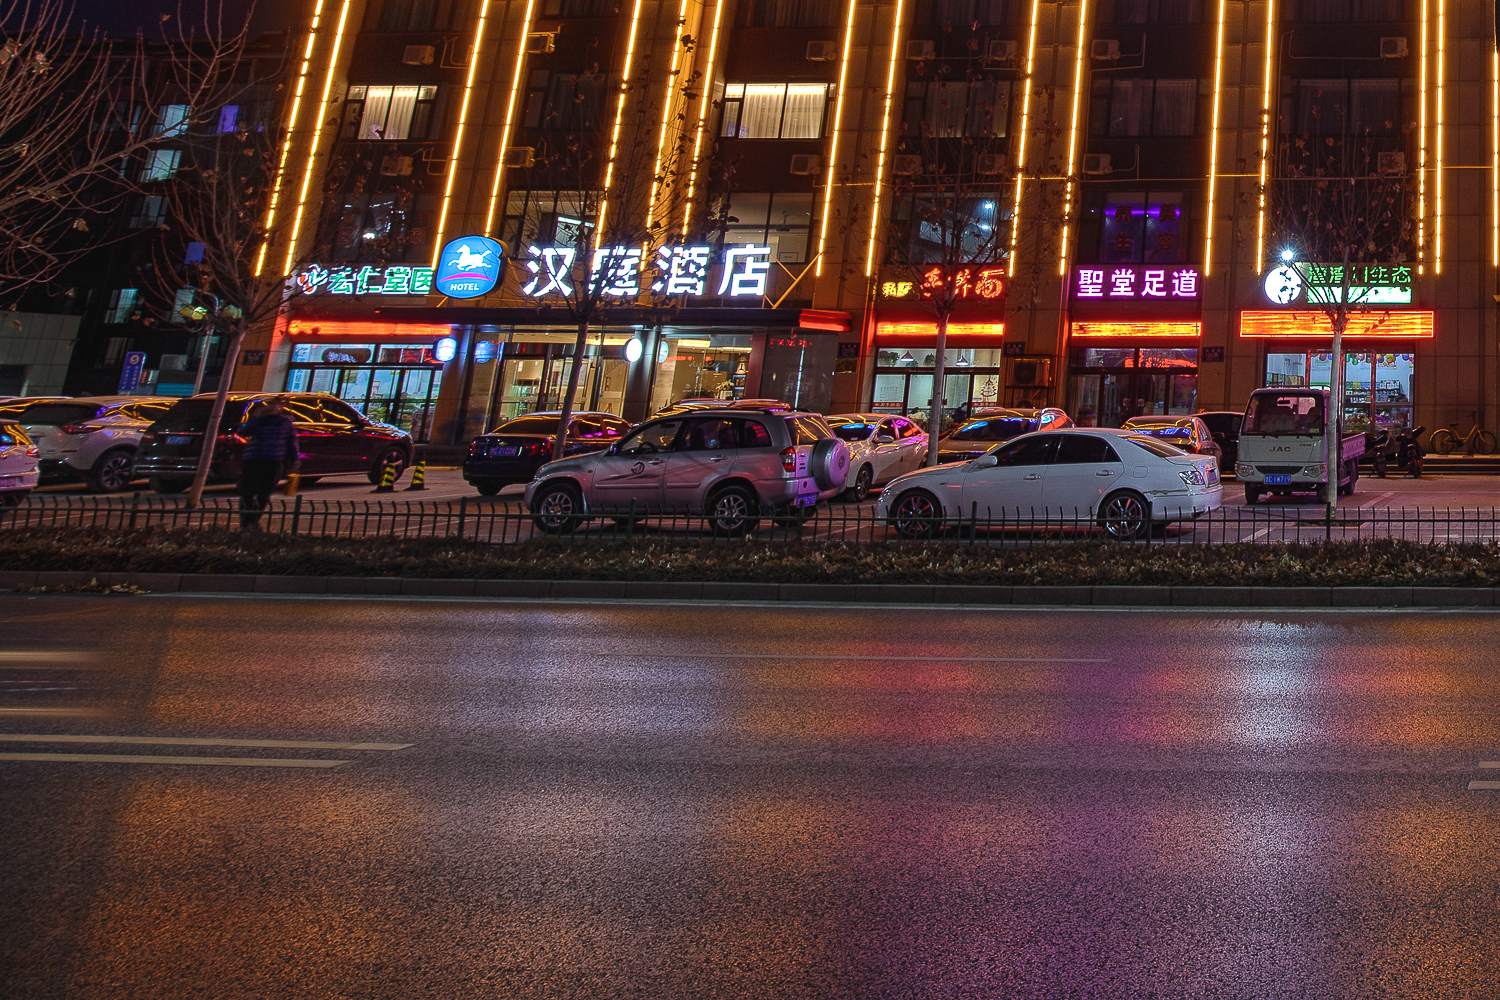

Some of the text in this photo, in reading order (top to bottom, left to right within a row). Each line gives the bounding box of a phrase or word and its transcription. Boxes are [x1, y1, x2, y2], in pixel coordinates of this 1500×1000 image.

[522, 244, 772, 297] 汉庭酒店
[1076, 268, 1198, 297] 聖堂足道
[450, 283, 480, 291] HOTEL
